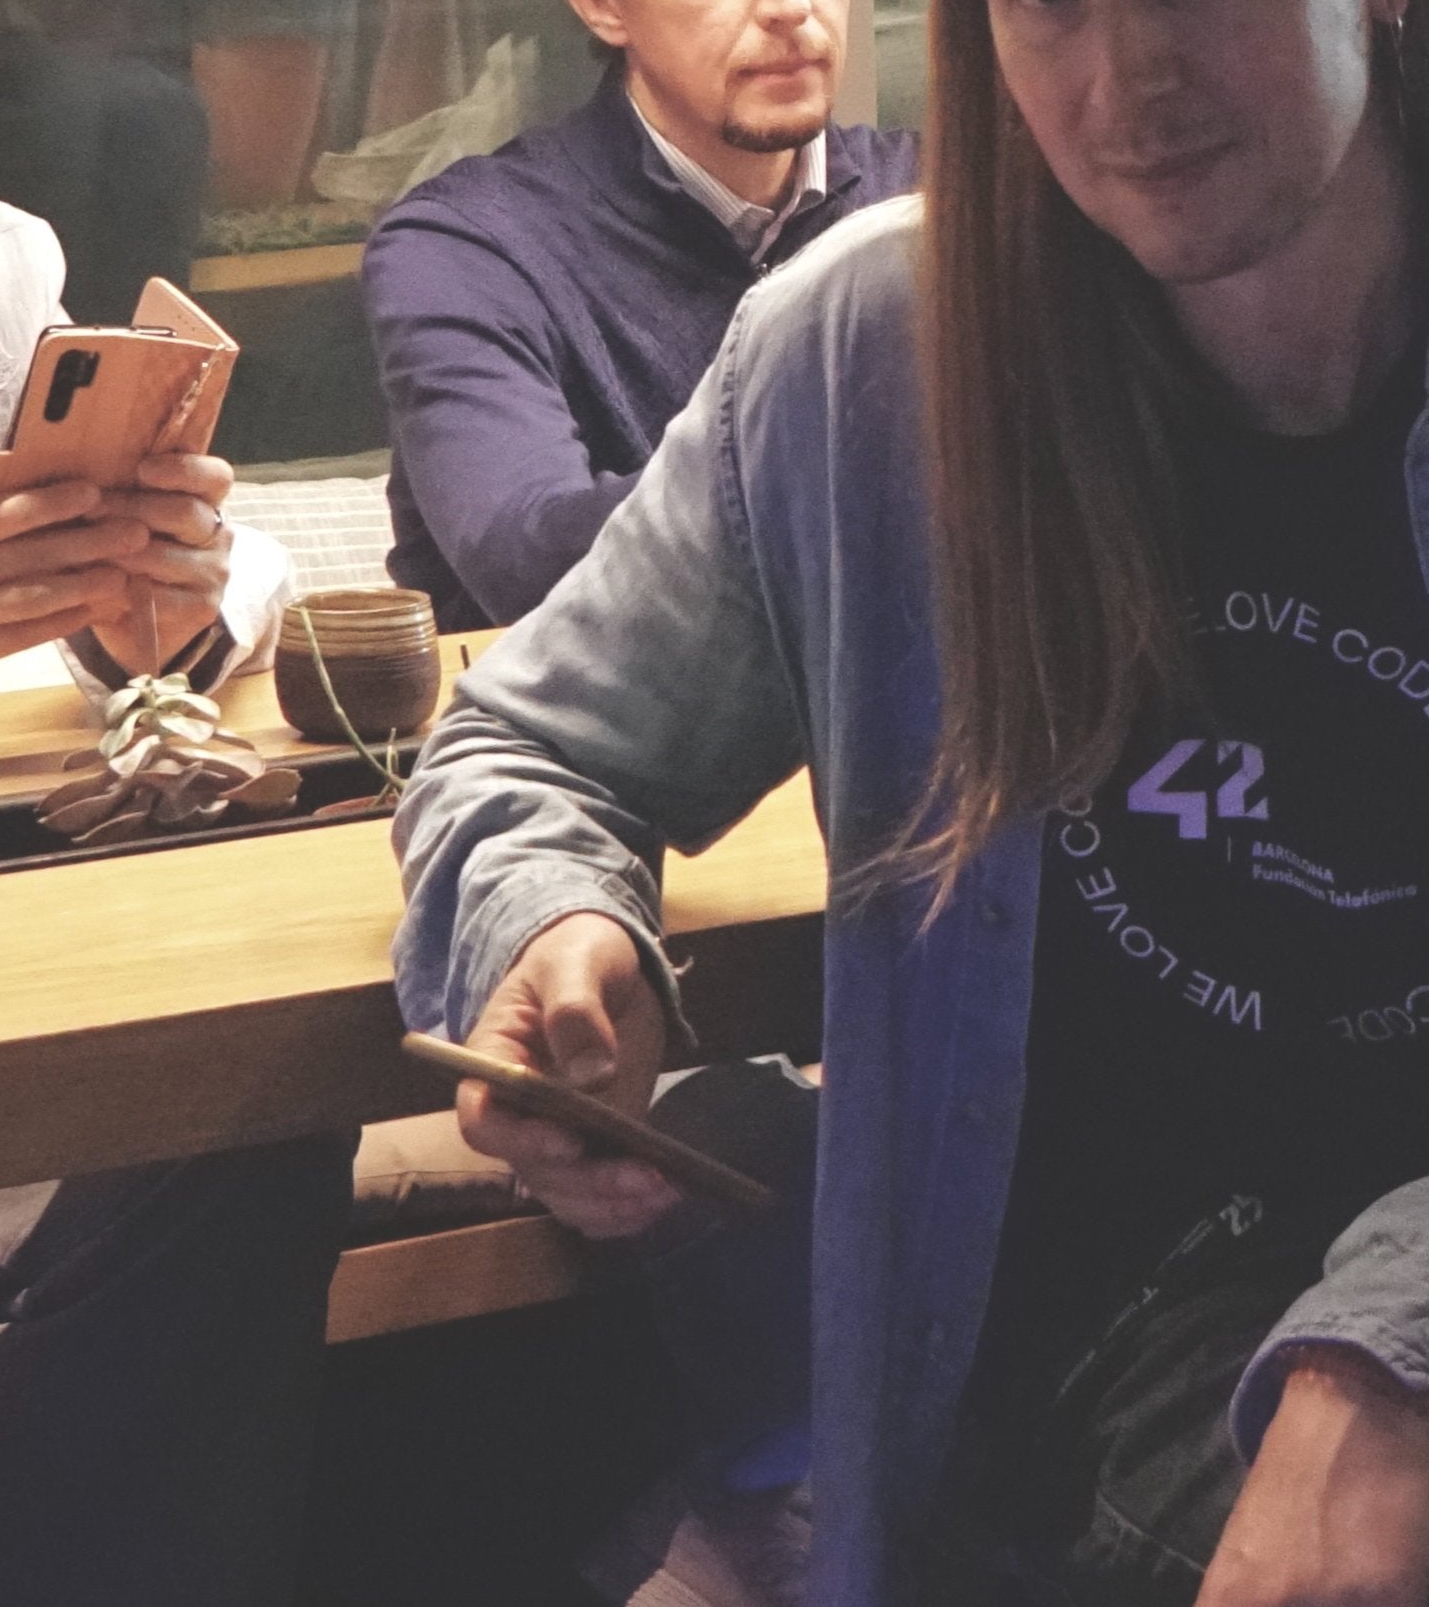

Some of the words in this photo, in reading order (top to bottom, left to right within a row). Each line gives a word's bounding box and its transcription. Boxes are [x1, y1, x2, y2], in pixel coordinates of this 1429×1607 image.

[1216, 589, 1321, 645] OVE
[1127, 738, 1269, 840] 42
[1074, 866, 1179, 980] LOVE
[1182, 969, 1262, 1032] WE
